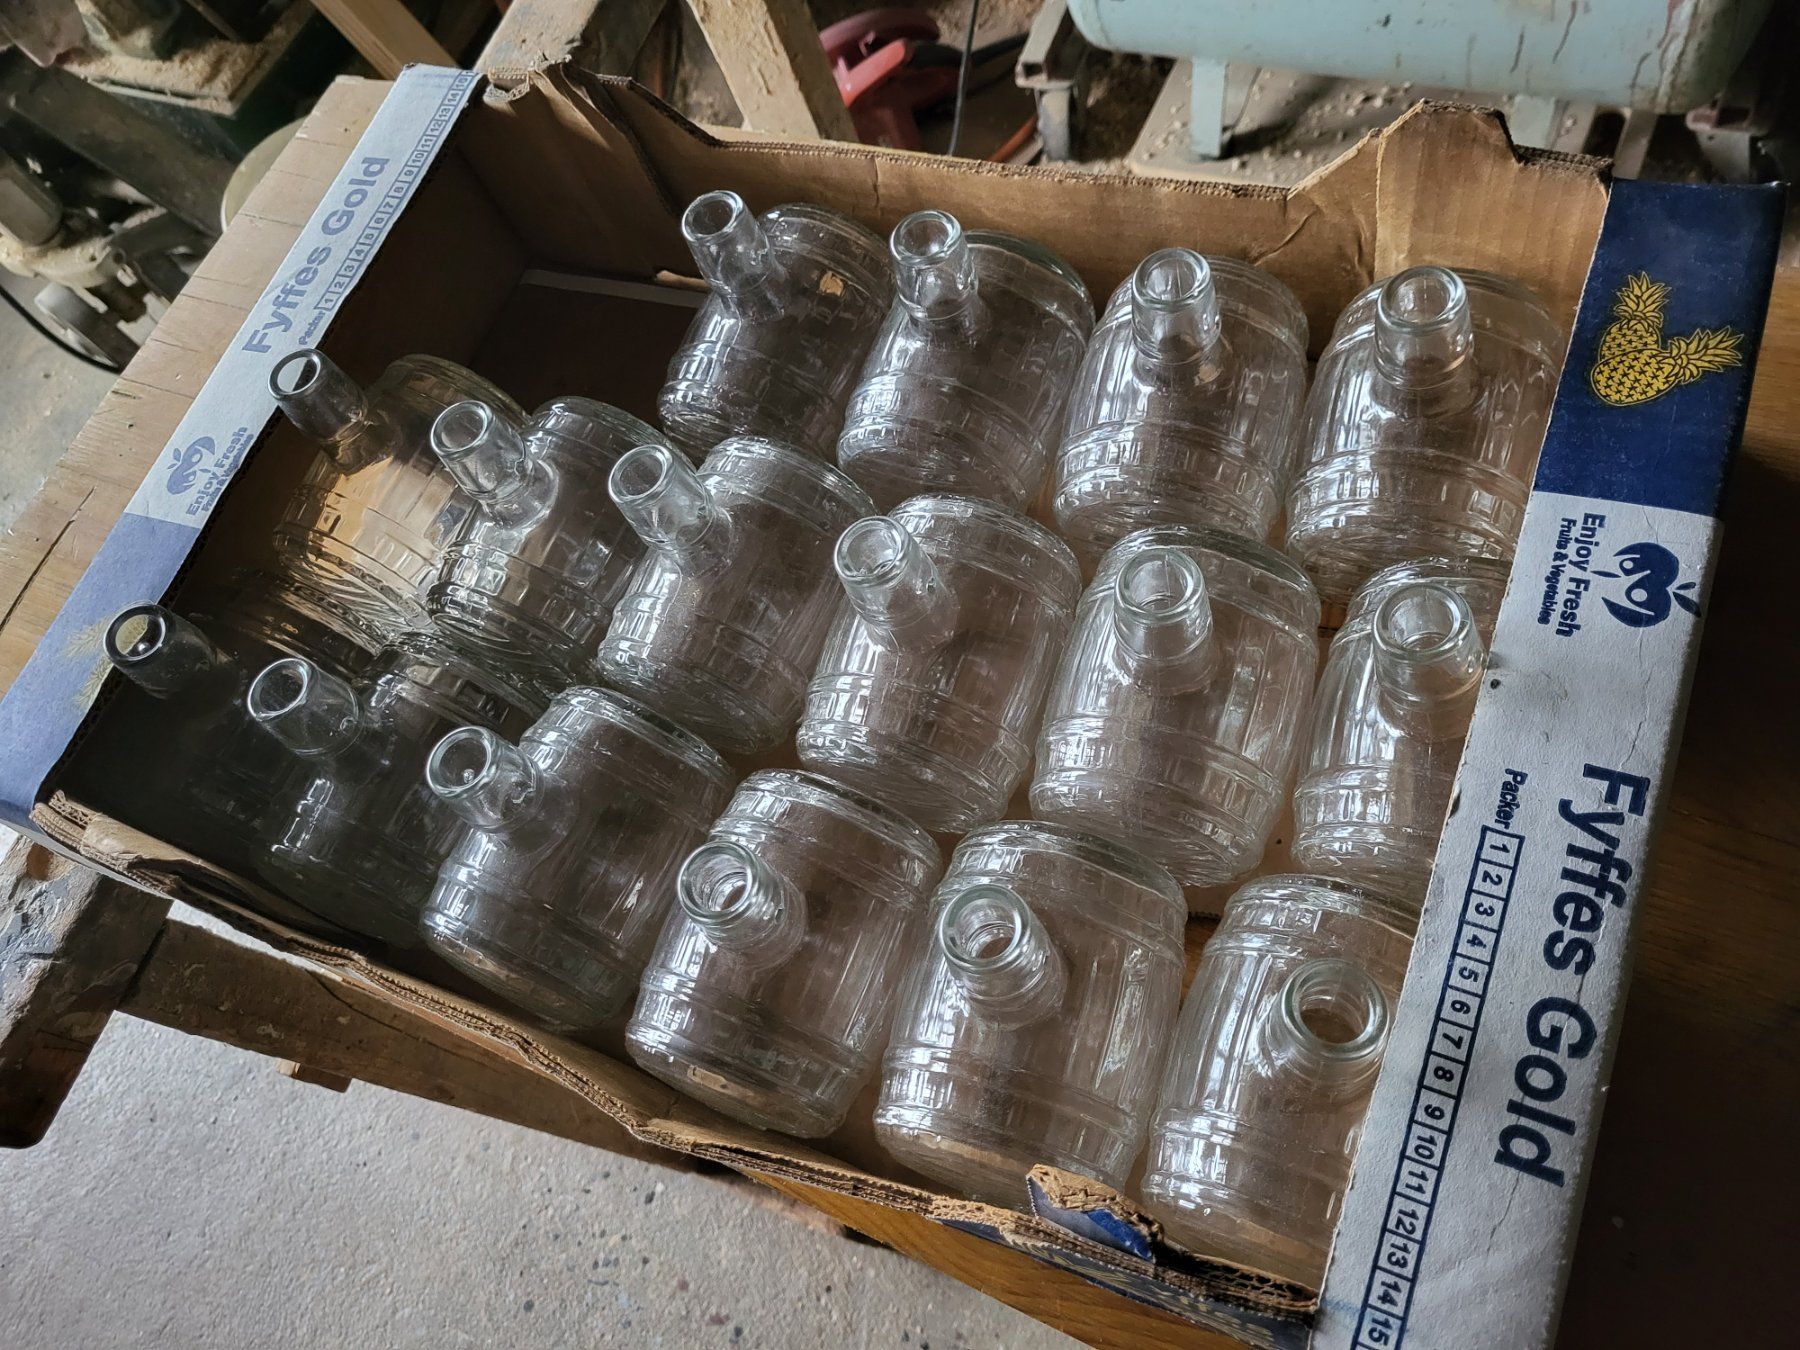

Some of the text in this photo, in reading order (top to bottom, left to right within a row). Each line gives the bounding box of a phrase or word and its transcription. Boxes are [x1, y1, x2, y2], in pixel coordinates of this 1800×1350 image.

[242, 157, 390, 353] Fyffes Gold
[334, 281, 345, 289] 2
[344, 264, 355, 272] 3
[354, 248, 365, 256] 4
[383, 201, 394, 209] 7
[411, 152, 425, 164] 10
[421, 137, 434, 149] 11
[430, 120, 443, 133] 12
[438, 107, 450, 119] 13
[447, 93, 459, 102] 14
[186, 427, 248, 515] Enjoy Fresh
[1537, 517, 1577, 625] Fruits & Vegetables
[1555, 512, 1606, 637] Enjoy Fresh
[1368, 768, 1528, 1347] Packer 1 2 3 4 5 6 7 8 9 10 11 12 13 14 15
[1493, 763, 1650, 1188] Fyffes Gold
